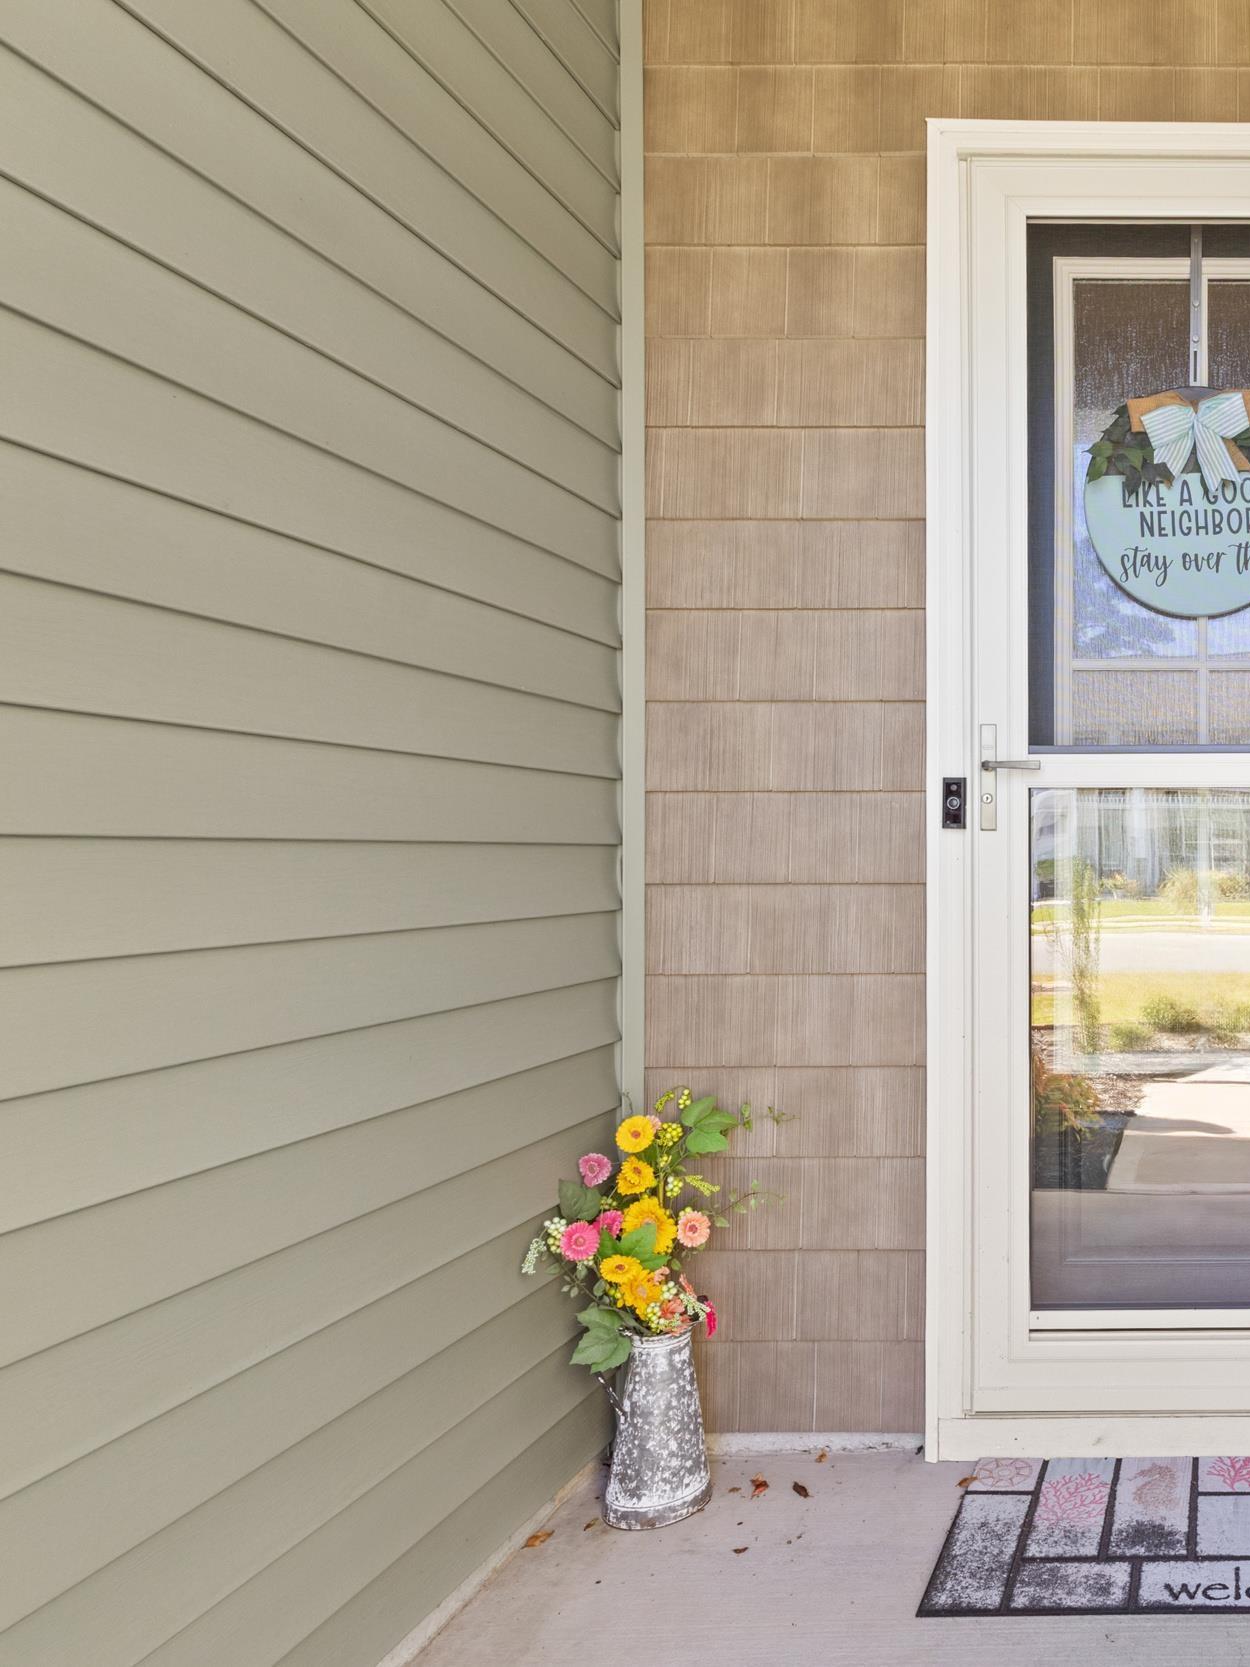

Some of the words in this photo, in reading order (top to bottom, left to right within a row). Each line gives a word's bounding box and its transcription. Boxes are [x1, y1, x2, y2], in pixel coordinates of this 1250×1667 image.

[1121, 480, 1167, 508] LIKE
[1179, 479, 1193, 507] A
[1119, 545, 1173, 588] stay
[1181, 550, 1227, 574] over
